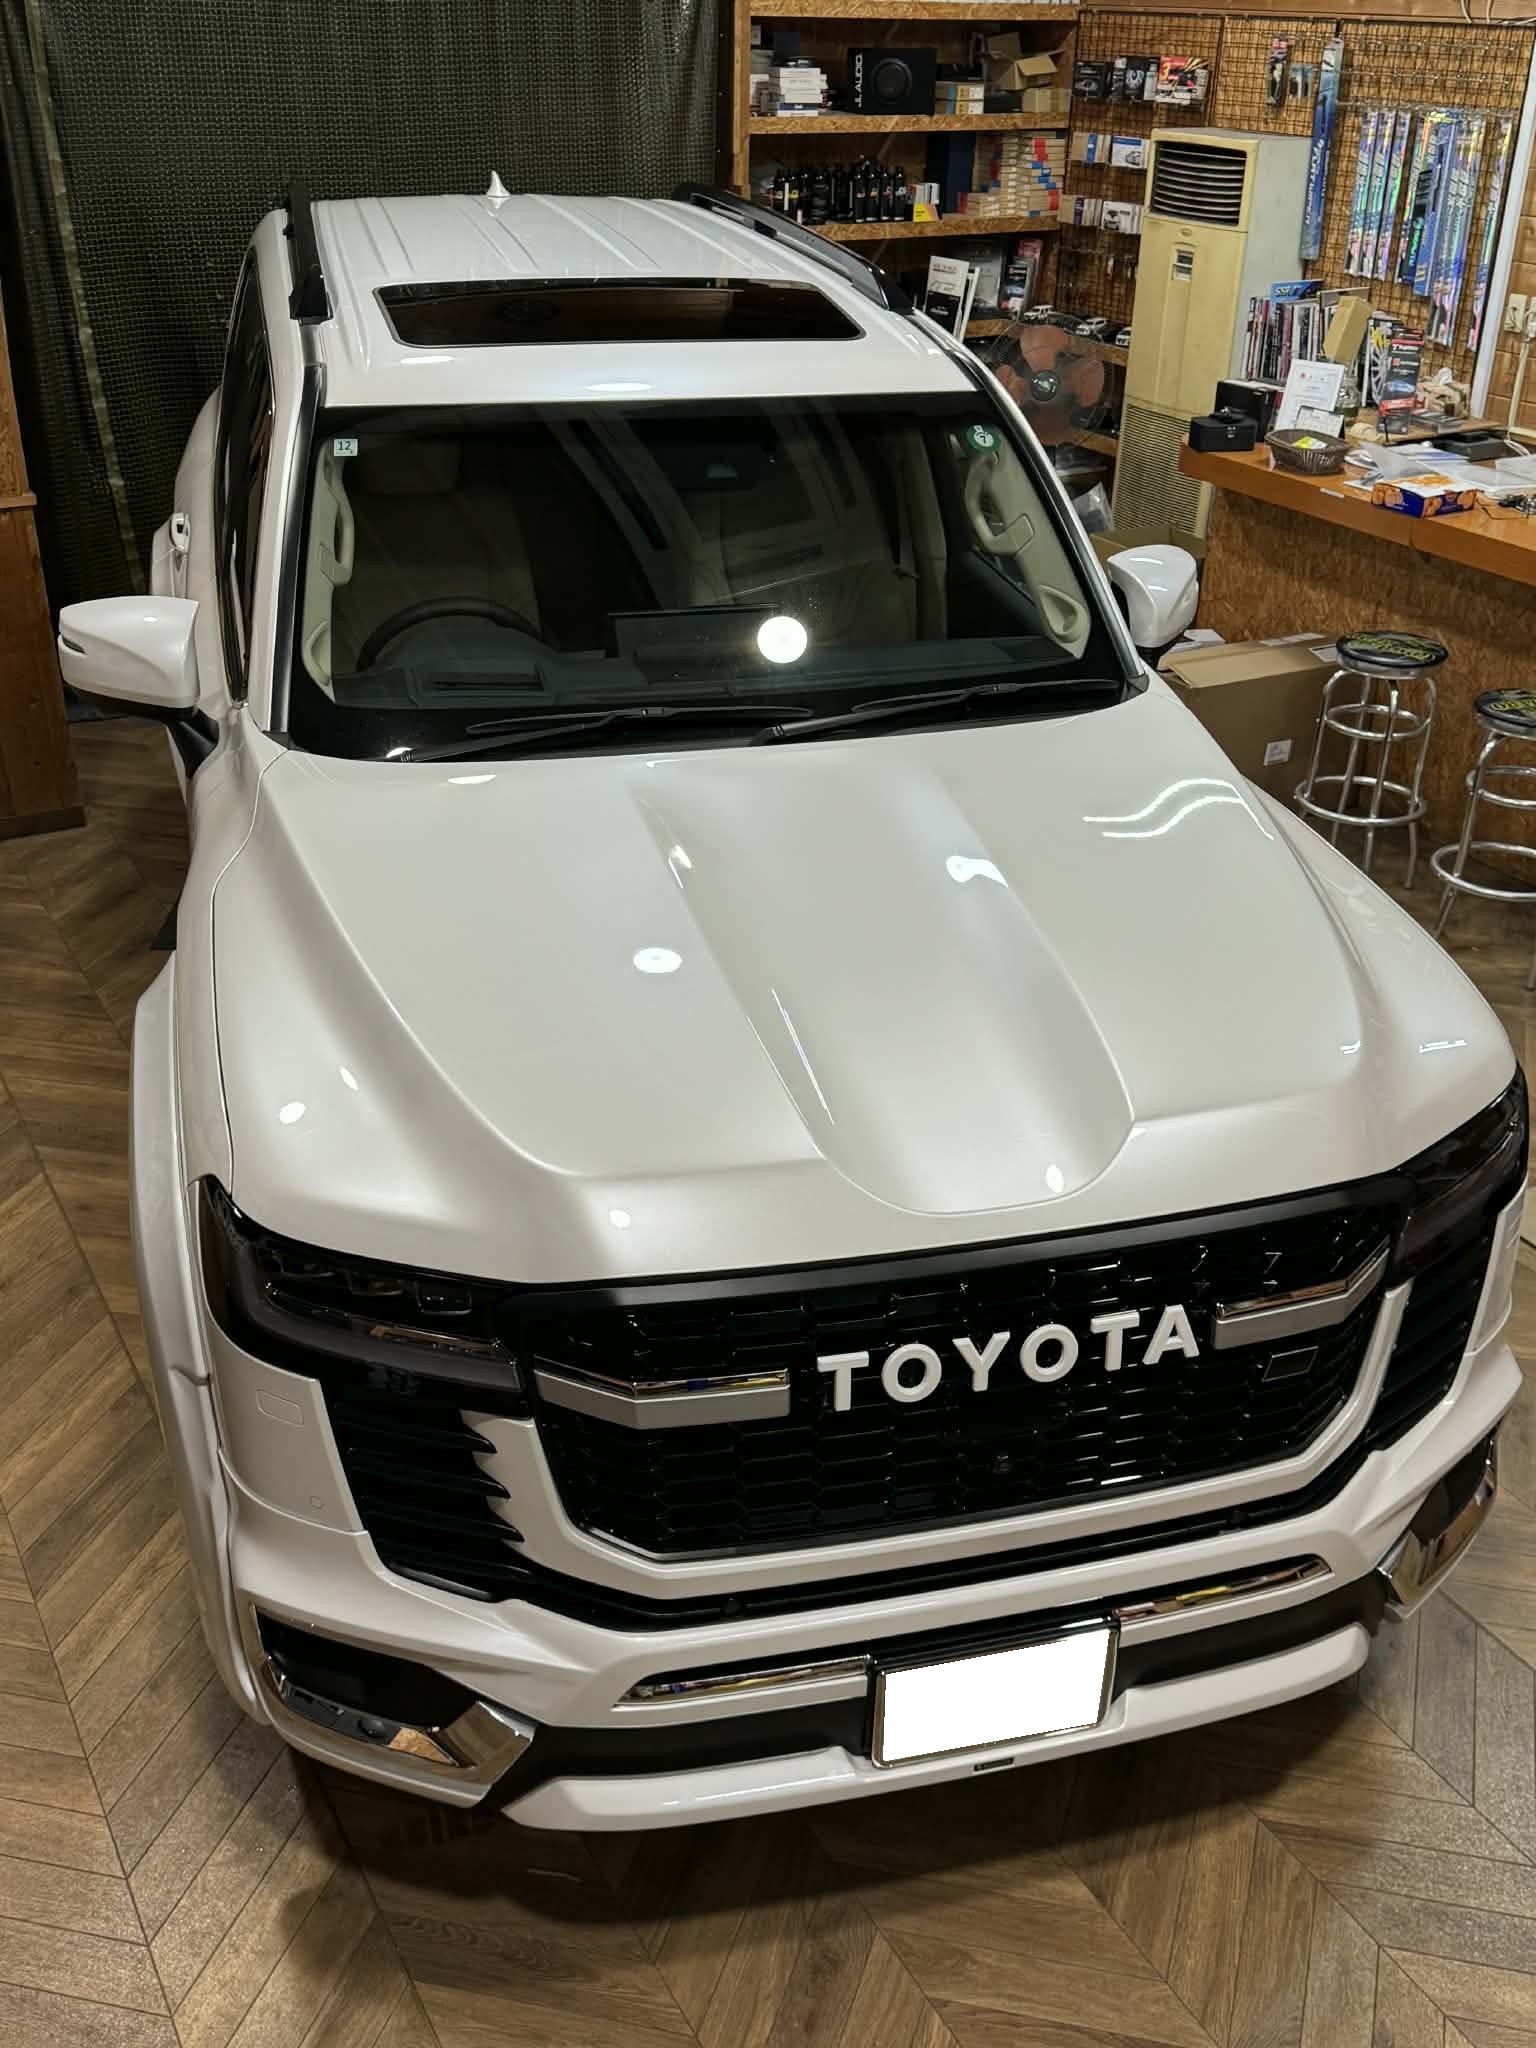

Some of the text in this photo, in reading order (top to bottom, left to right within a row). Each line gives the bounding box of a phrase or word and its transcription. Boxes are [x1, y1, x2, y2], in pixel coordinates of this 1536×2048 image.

[854, 54, 863, 92] AUDIO
[337, 440, 352, 451] 12
[817, 1304, 1200, 1411] TOYOTA
